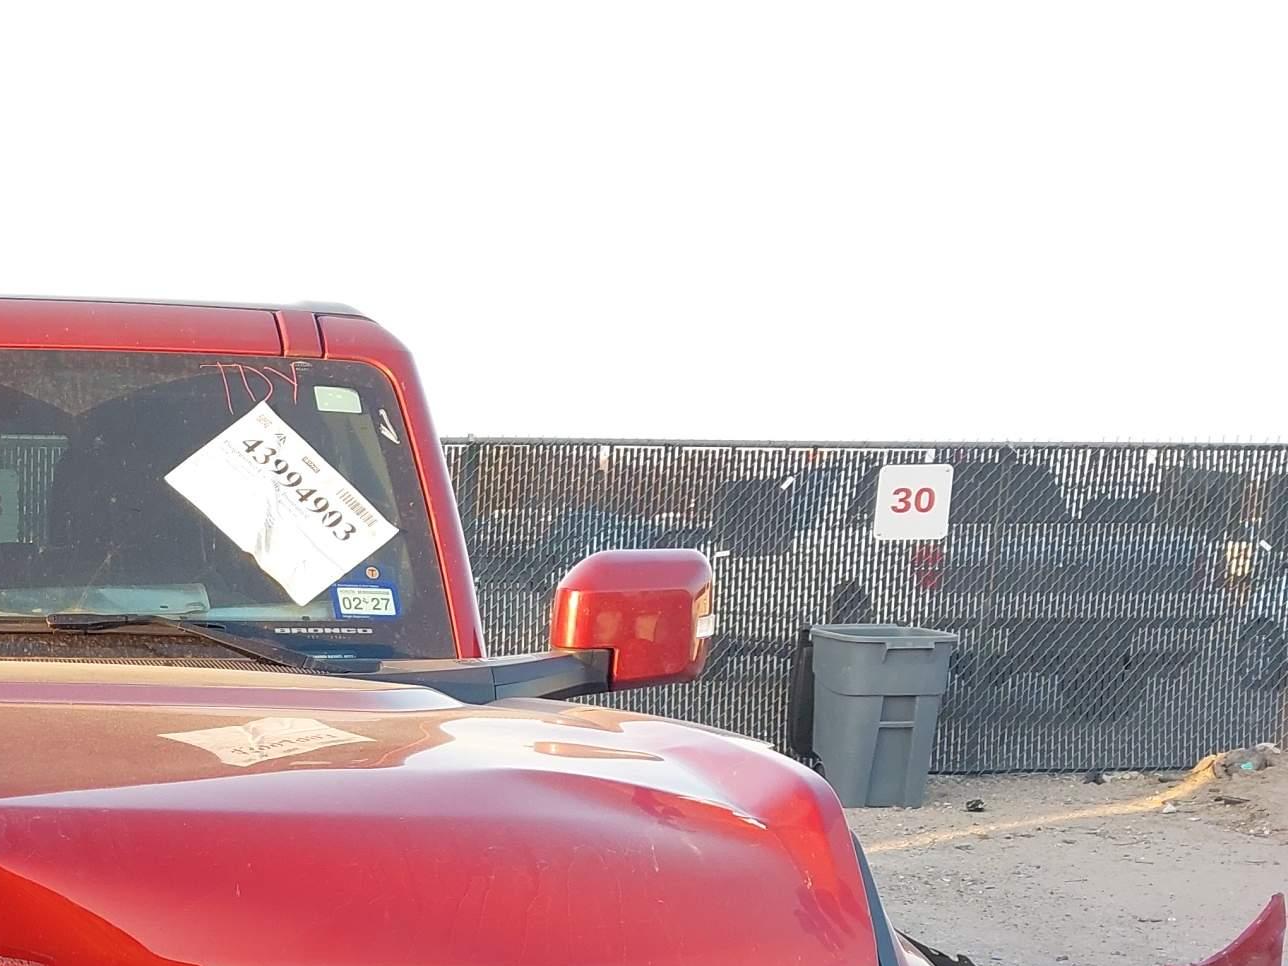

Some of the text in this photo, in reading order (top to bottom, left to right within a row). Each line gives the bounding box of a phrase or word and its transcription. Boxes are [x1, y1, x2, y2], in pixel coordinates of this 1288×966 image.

[242, 439, 357, 541] 43994903
[890, 487, 936, 513] 30
[342, 596, 391, 611] 02 27
